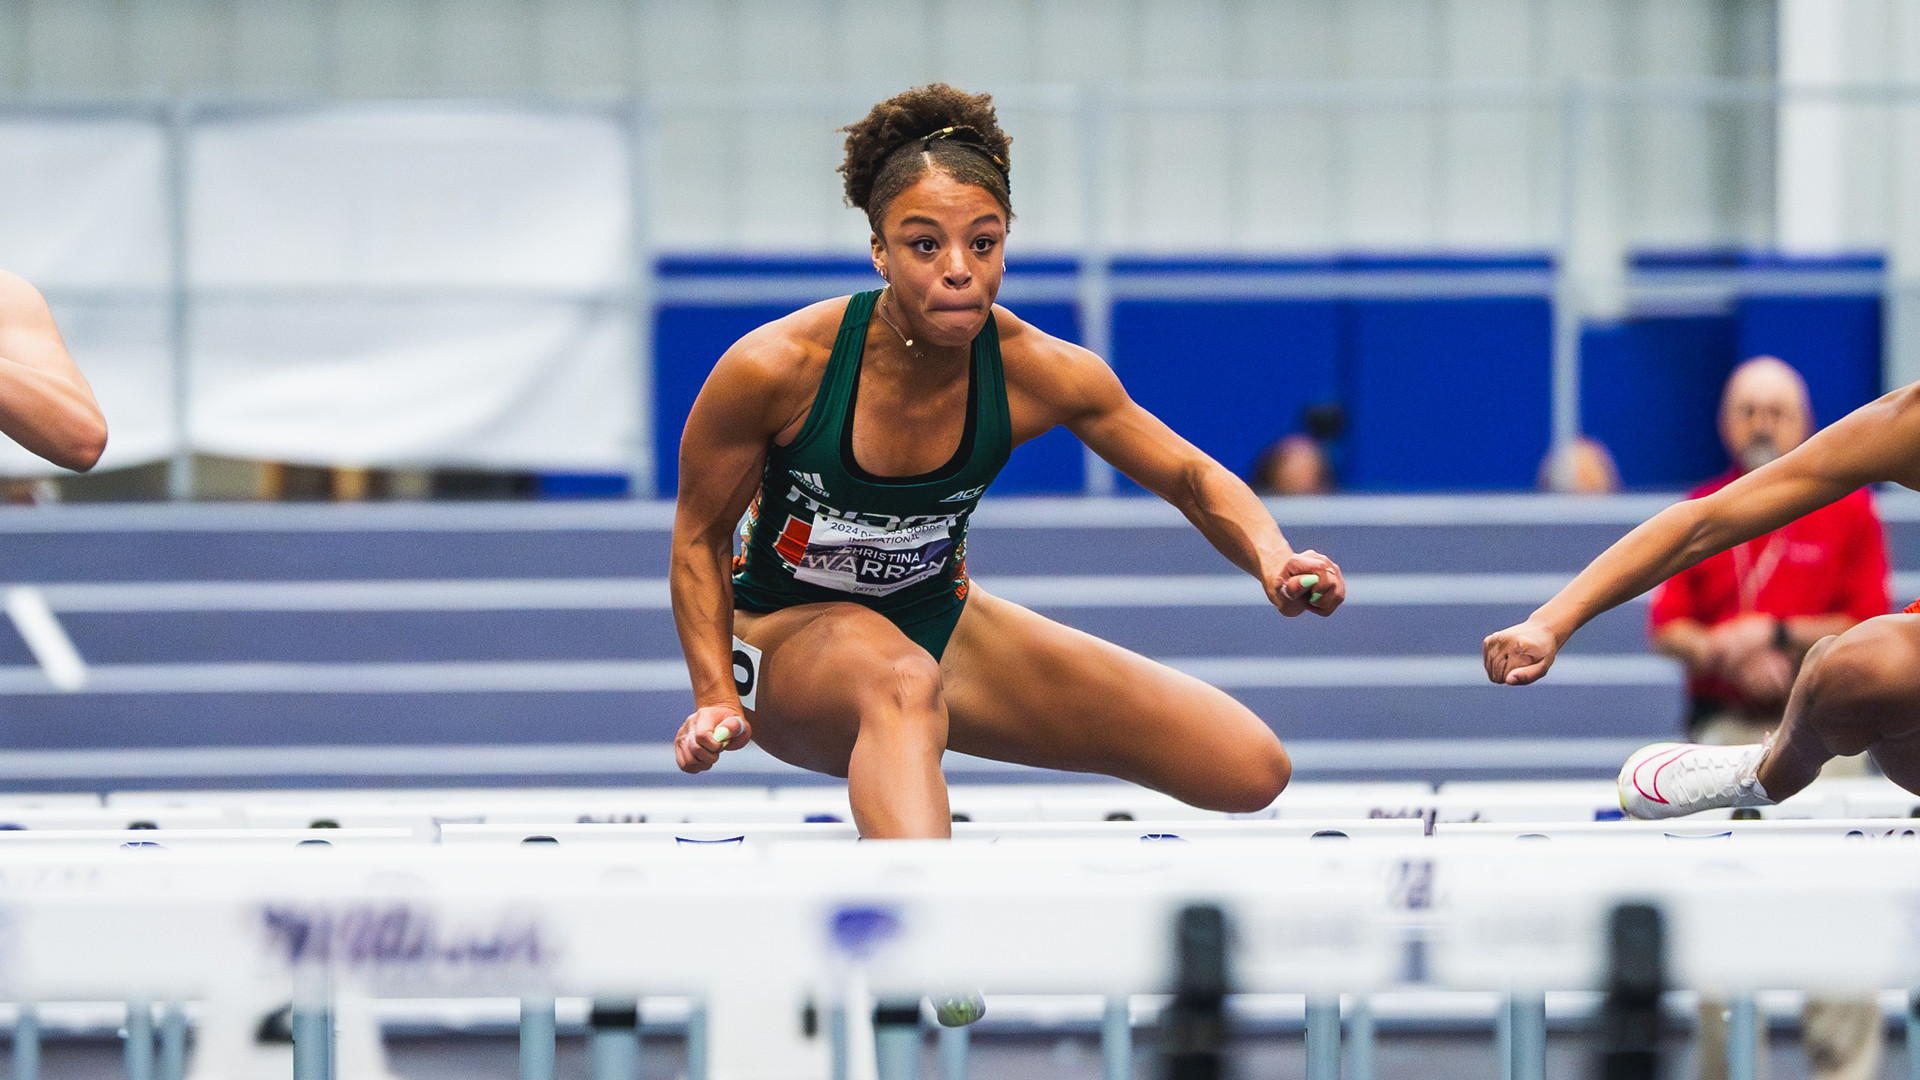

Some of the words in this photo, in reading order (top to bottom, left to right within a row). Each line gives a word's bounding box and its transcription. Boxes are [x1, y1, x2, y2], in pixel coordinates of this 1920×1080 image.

[940, 484, 986, 502] ACC
[831, 522, 859, 535] 2024
[841, 546, 920, 563] CHRISTINA
